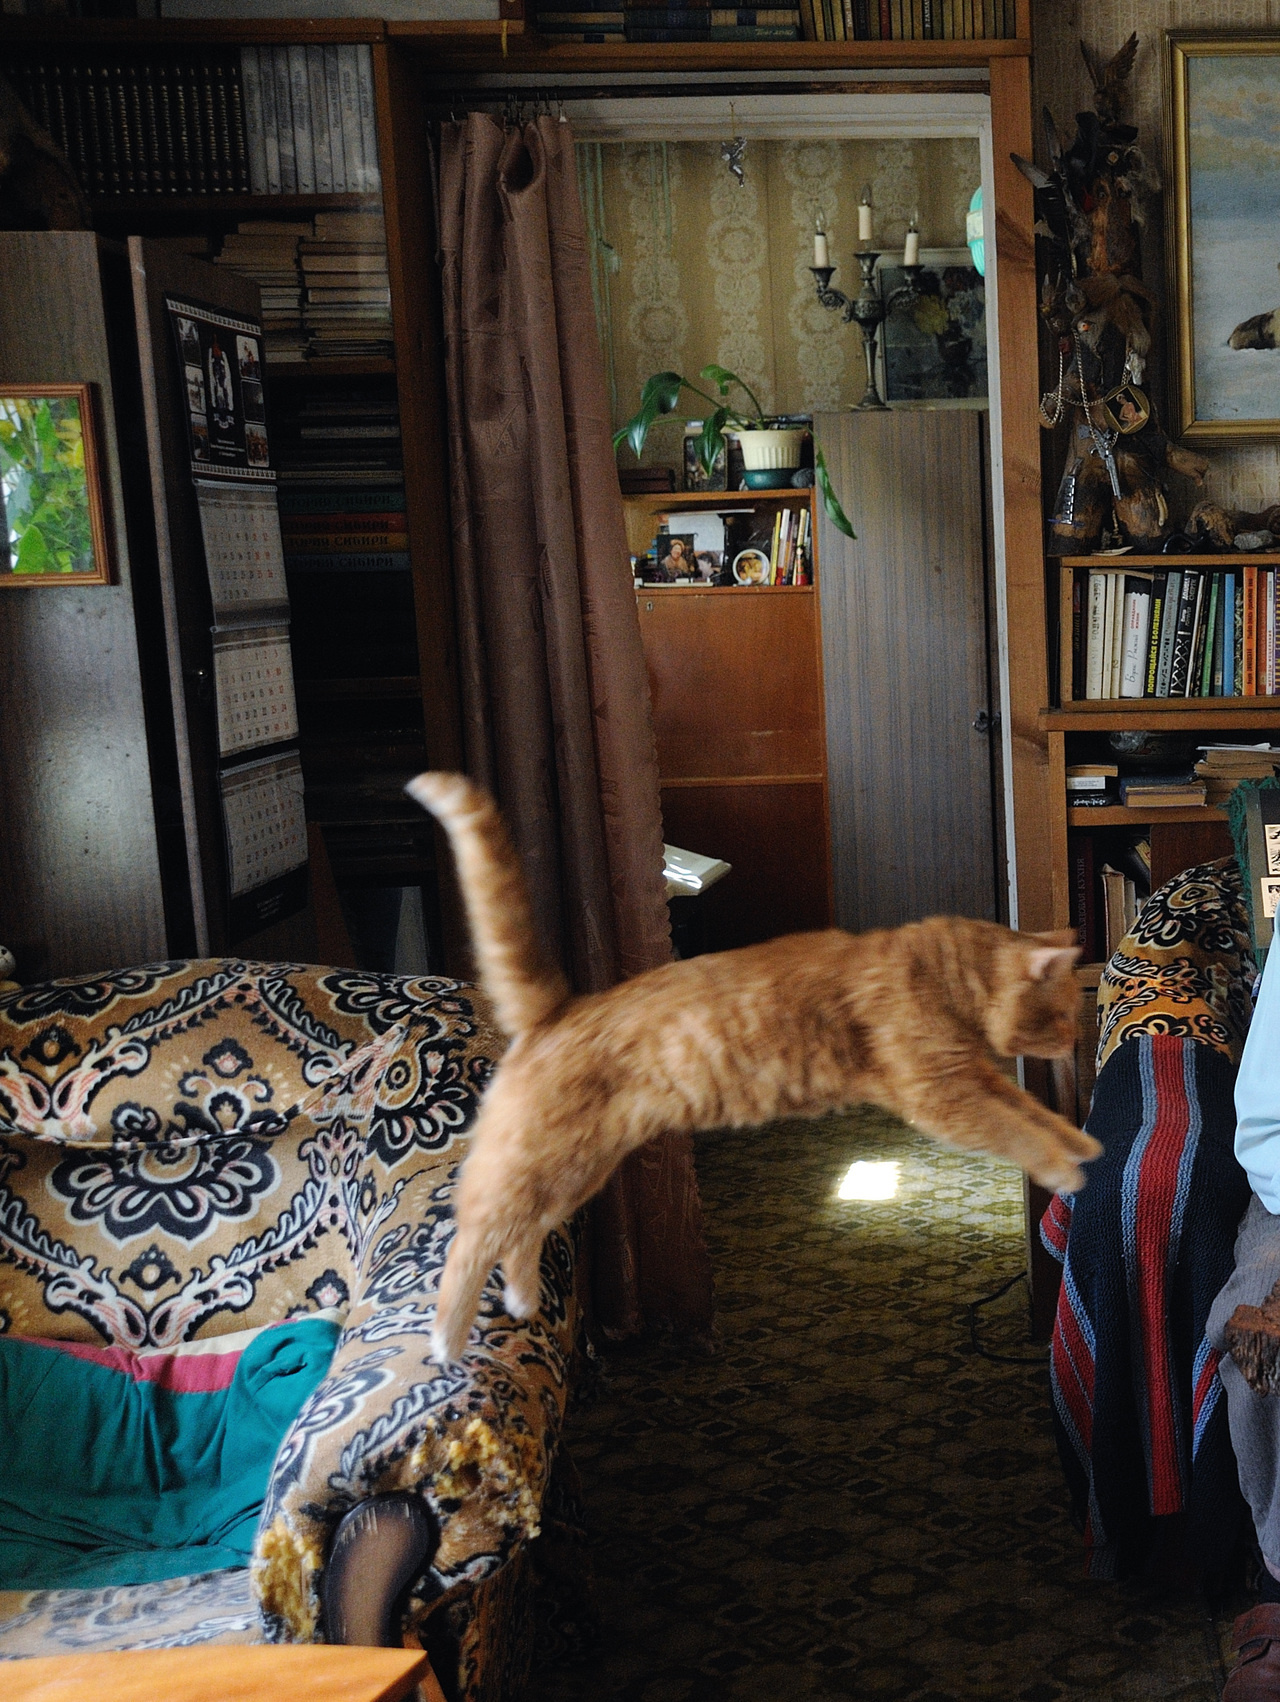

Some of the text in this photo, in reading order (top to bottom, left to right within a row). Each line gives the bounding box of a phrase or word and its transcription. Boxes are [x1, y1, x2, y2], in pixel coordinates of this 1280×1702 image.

[334, 536, 388, 547] СИБИРИ
[339, 557, 393, 567] СИБИРИ
[1152, 598, 1162, 639] БОЛЕЗНЯМИ
[1147, 646, 1158, 693] ПОПРОЩАЙСЯ
[1077, 858, 1085, 889] КУХНЯ
